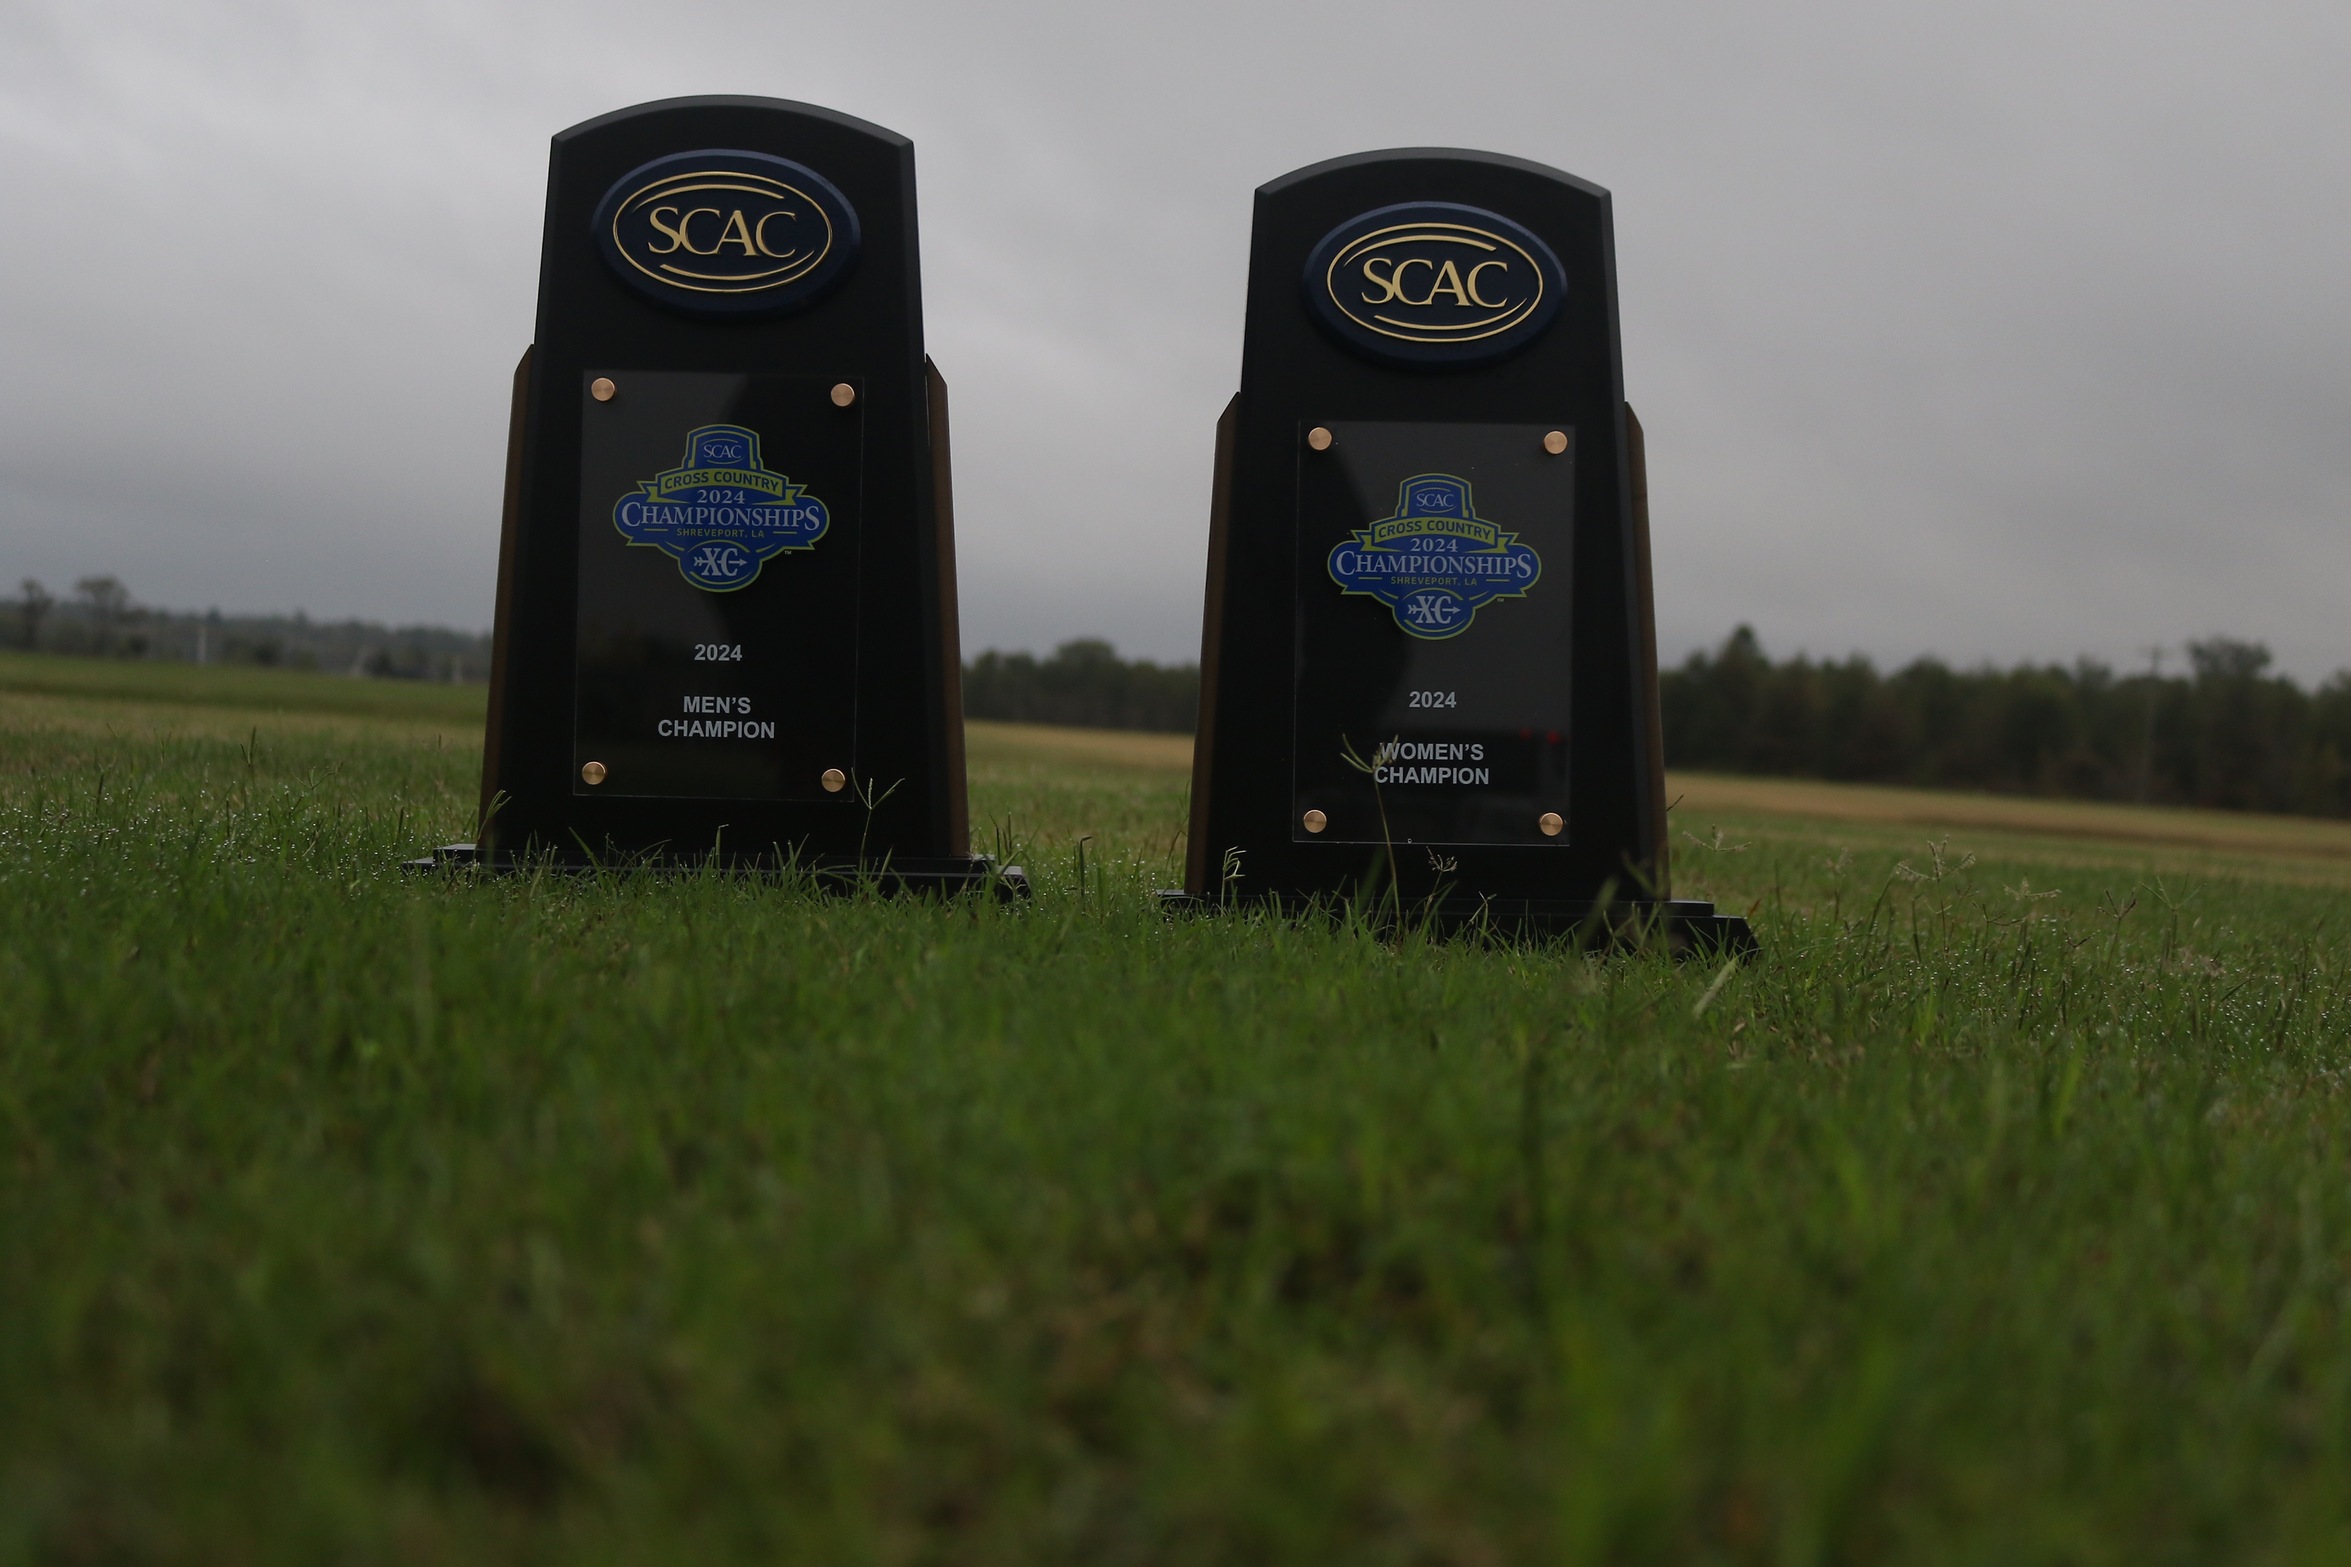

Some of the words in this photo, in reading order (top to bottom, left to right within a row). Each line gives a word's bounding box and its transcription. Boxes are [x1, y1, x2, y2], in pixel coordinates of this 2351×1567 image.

[647, 206, 797, 258] SCAC
[1361, 257, 1508, 308] SCAC
[703, 444, 742, 459] SCAC
[664, 471, 709, 490] CROSS
[714, 471, 779, 492] COUNTRY
[696, 489, 745, 504] 2024
[1416, 493, 1455, 508] SCAC
[621, 501, 820, 531] CHAMPIONSHIPS
[751, 529, 764, 538] LA
[1378, 520, 1422, 538] CROSS
[1427, 520, 1492, 540] COUNTRY
[1410, 538, 1458, 553] 2024
[701, 547, 738, 576] XC
[1335, 550, 1532, 579] CHAMPIONSHIPS
[1464, 577, 1478, 586] LA
[1415, 595, 1452, 624] XC
[694, 643, 743, 662] 2024
[1409, 690, 1457, 708] 2024
[657, 719, 775, 739] CHAMPION
[1374, 766, 1490, 785] CHAMPION
